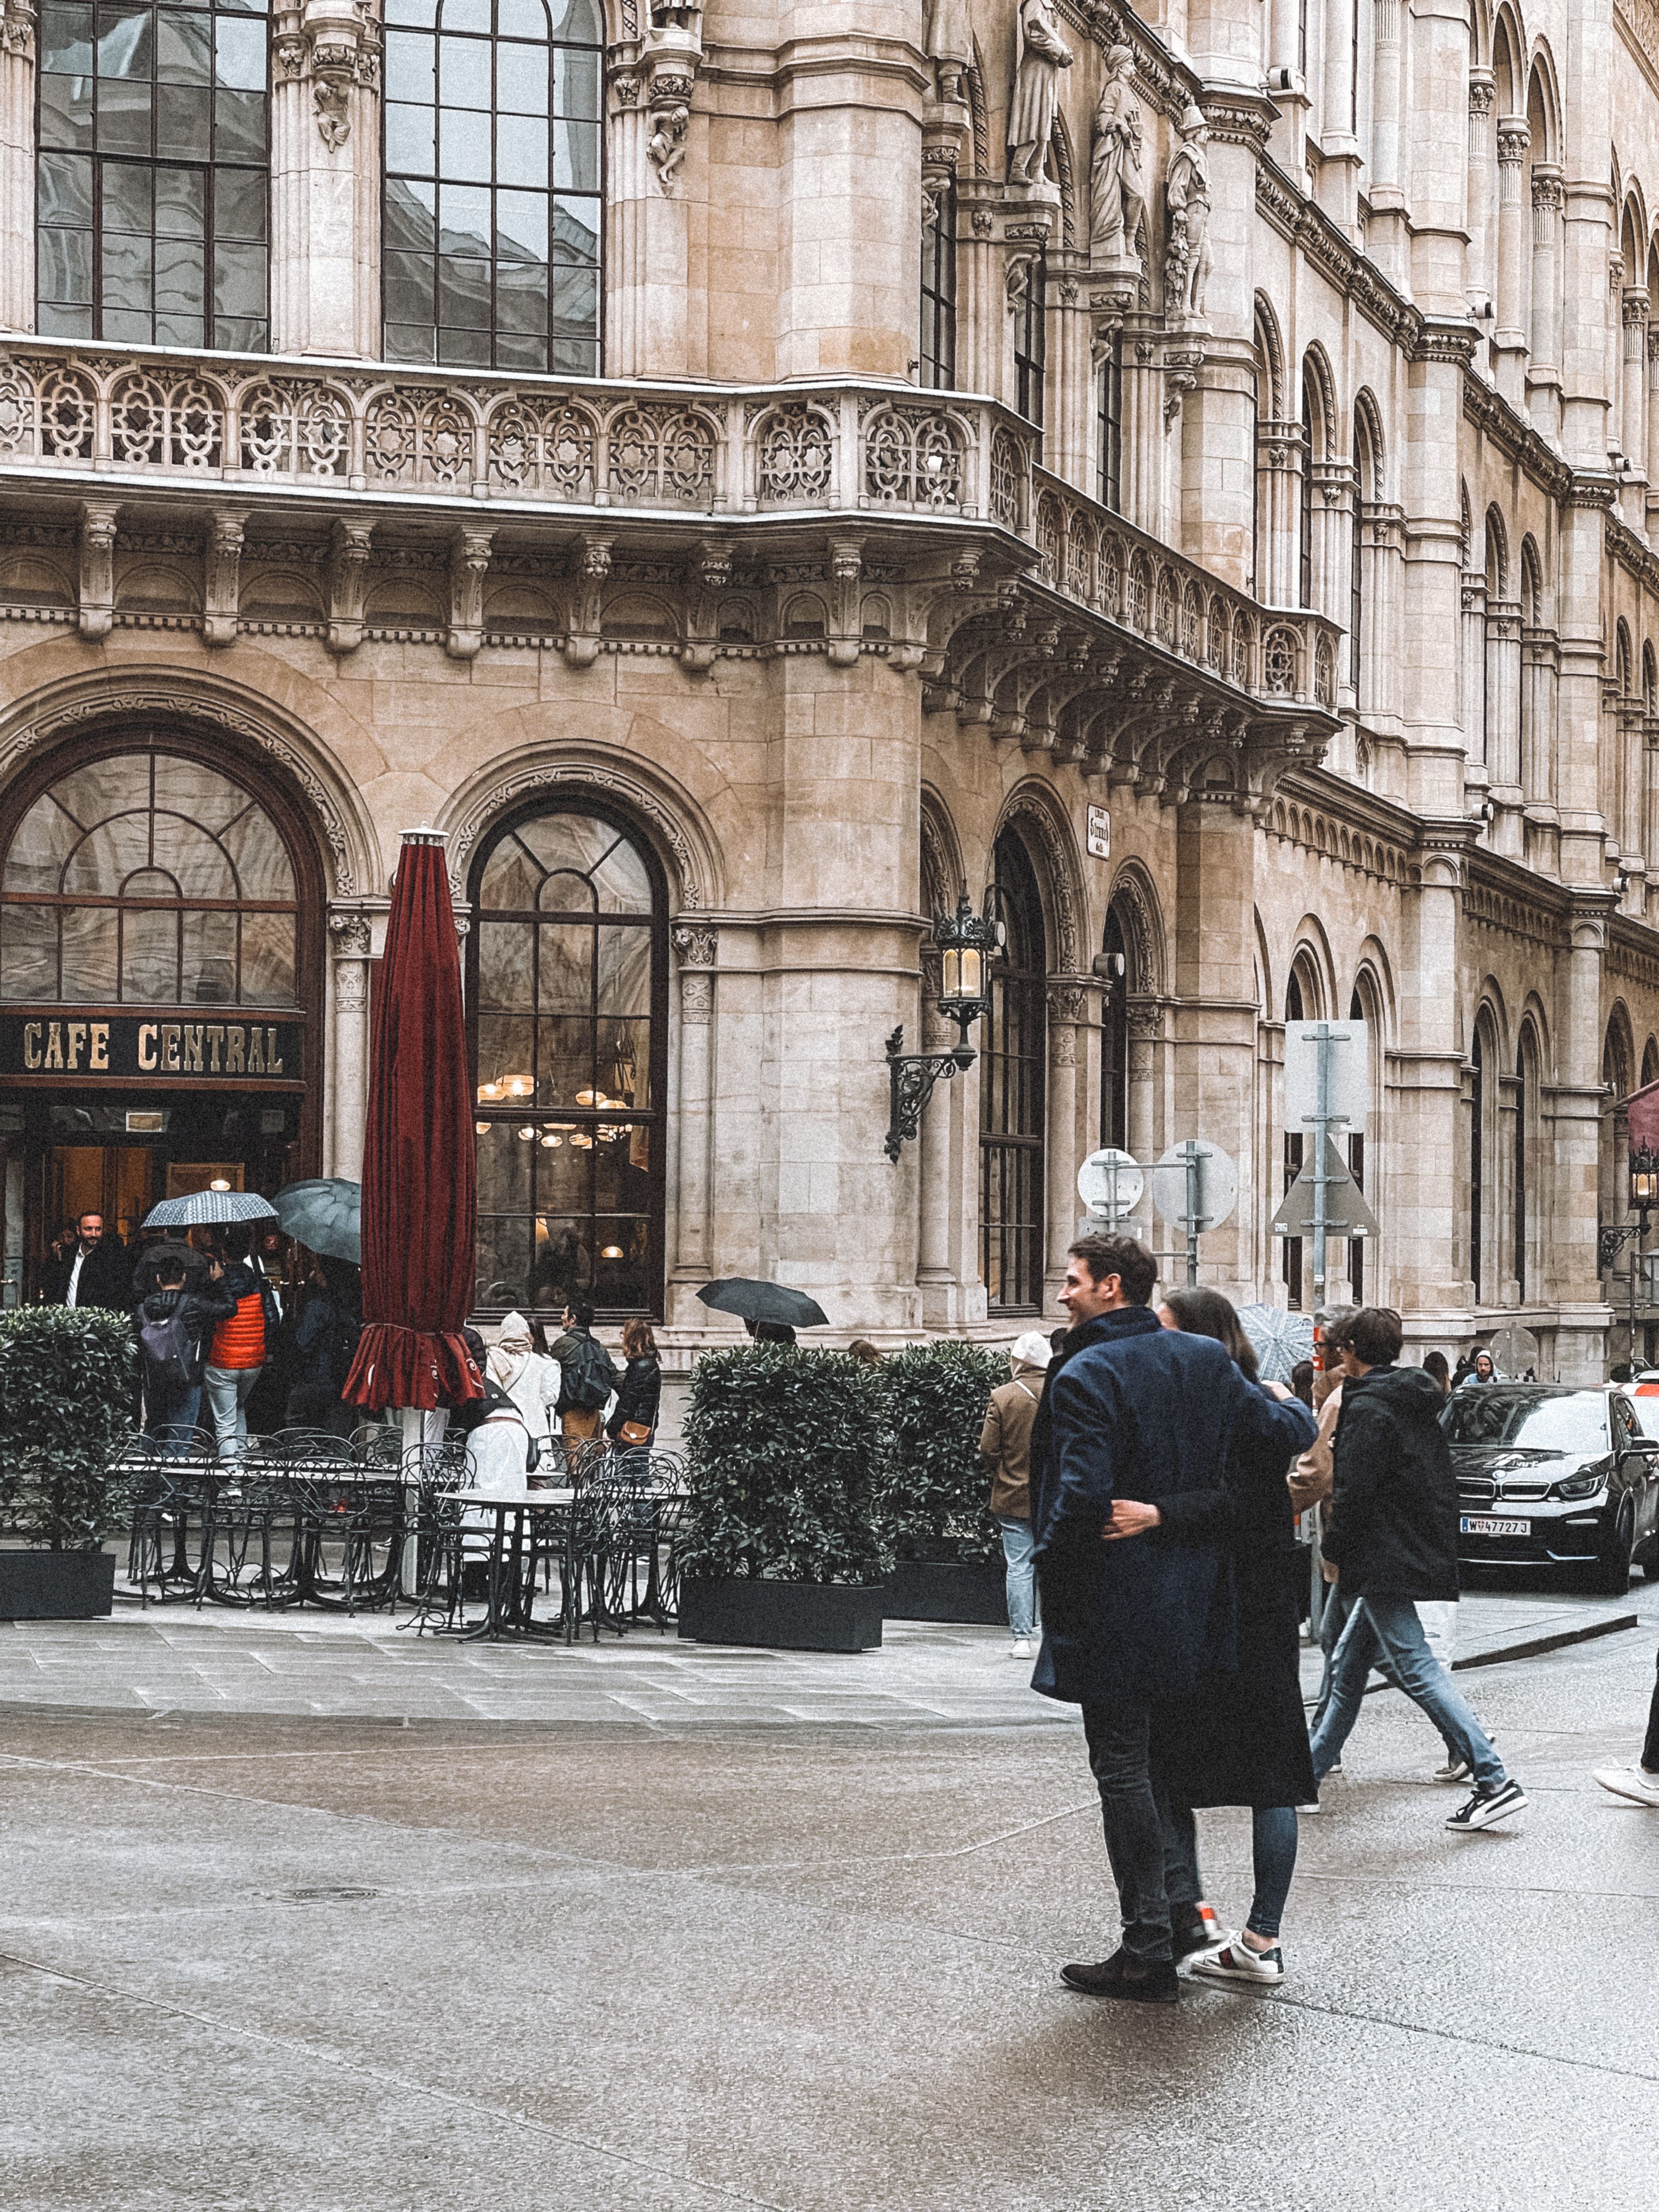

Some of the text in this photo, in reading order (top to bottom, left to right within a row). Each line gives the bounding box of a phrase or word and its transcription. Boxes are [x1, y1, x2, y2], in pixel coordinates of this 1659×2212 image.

[24, 1023, 283, 1074] CAFE CENTRAL
[1469, 1520, 1527, 1533] W 47727 J
